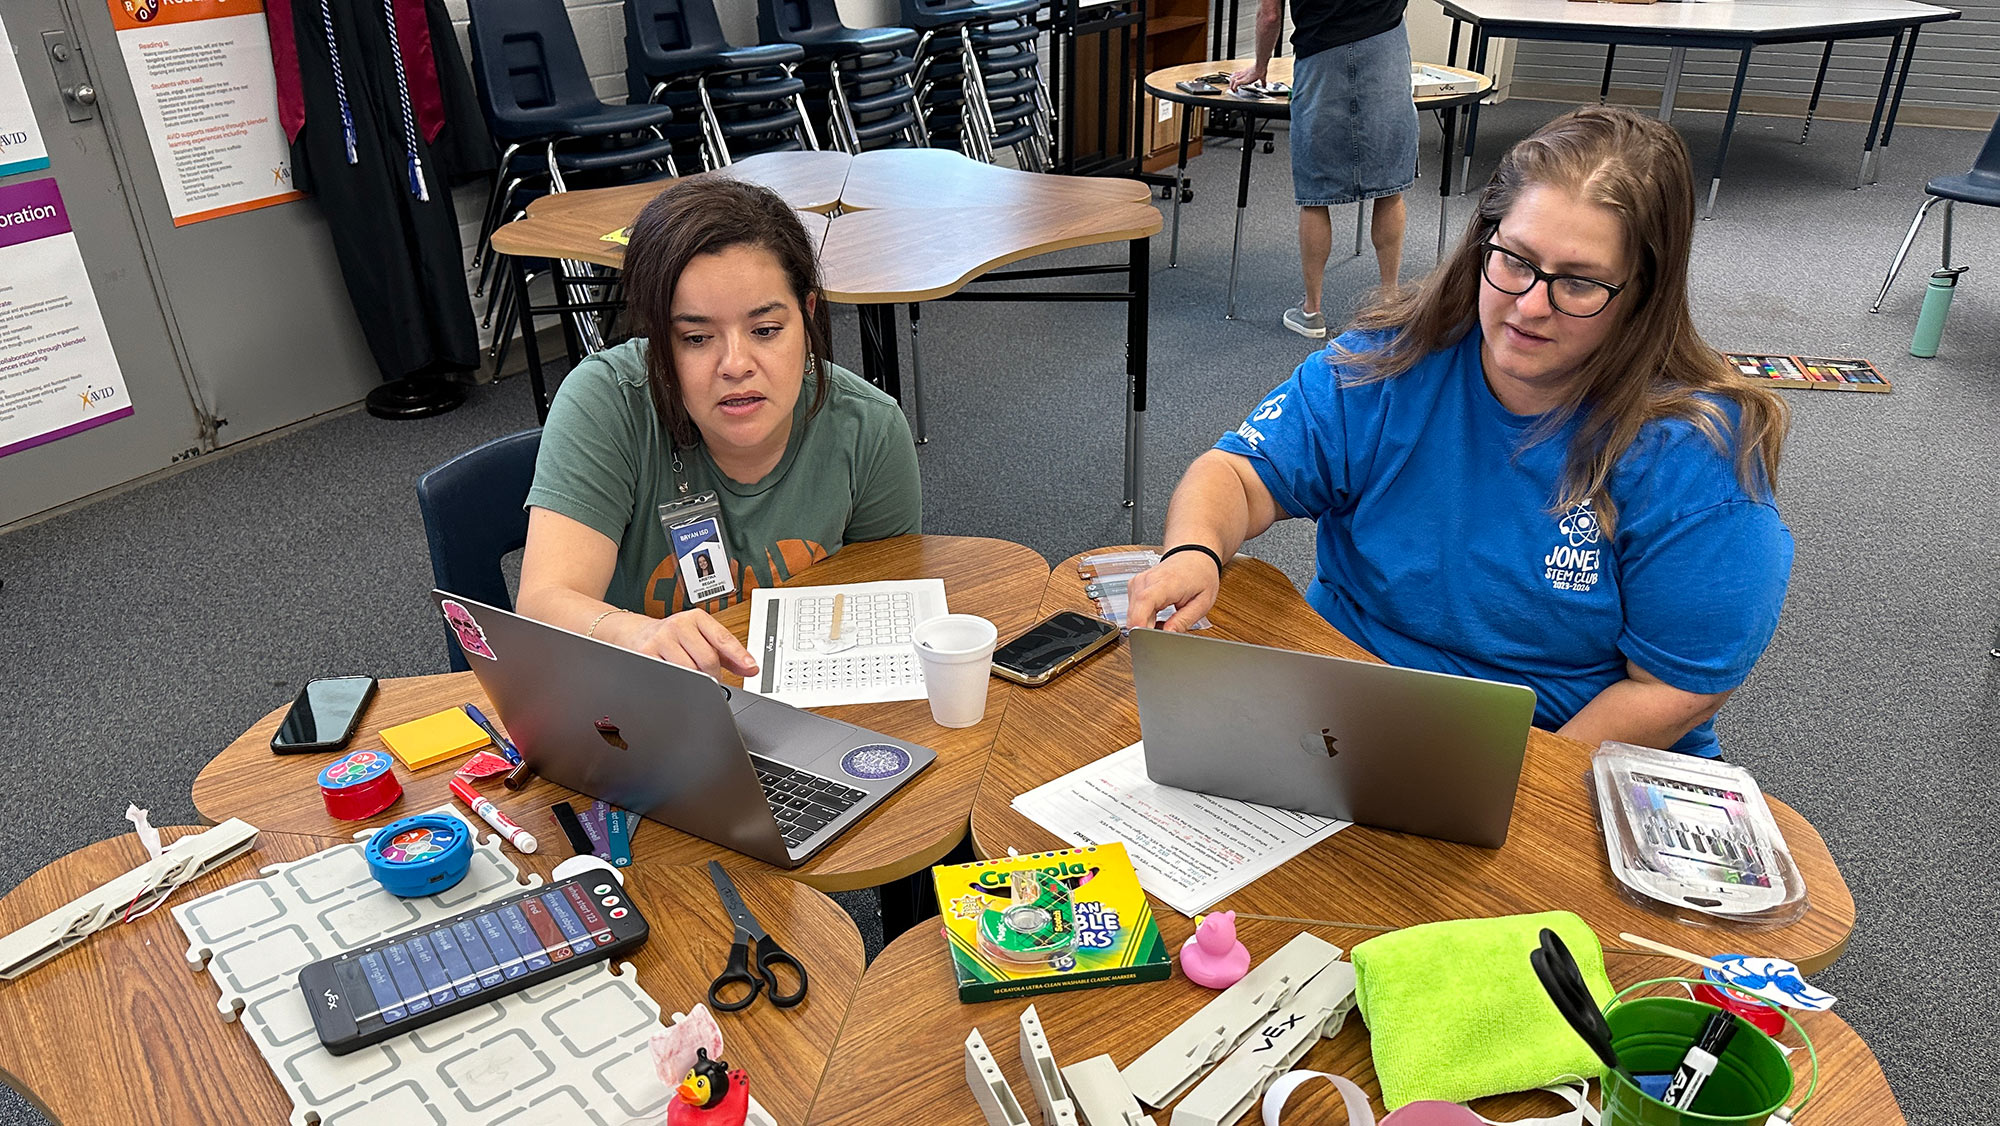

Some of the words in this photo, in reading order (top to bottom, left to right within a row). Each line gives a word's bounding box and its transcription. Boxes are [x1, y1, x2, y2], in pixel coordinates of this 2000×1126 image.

[0, 132, 27, 145] AVID
[37, 343, 61, 355] through
[61, 335, 86, 347] blended
[89, 386, 114, 403] AVID
[680, 531, 698, 542] BRYAN
[1545, 568, 1574, 581] STEM
[1574, 571, 1598, 584] CLUB
[1553, 580, 1590, 592] 2023-2024
[980, 861, 1086, 886] Crola
[528, 902, 541, 914] red
[567, 885, 580, 900] when
[576, 898, 590, 914] start
[585, 912, 597, 923] 123
[505, 906, 518, 920] turn
[545, 892, 560, 907] drive
[559, 916, 578, 936] object
[1053, 910, 1063, 932] Scotch
[458, 921, 474, 937] drive
[480, 914, 493, 928] turn
[487, 926, 500, 938] left
[510, 918, 528, 935] right
[434, 929, 449, 945] drive
[388, 945, 404, 962] drive
[411, 938, 425, 952] turn
[418, 950, 432, 962] left
[364, 953, 378, 967] turn
[368, 966, 389, 984] right
[323, 989, 339, 1010] VEX
[1252, 1013, 1306, 1053] VEX
